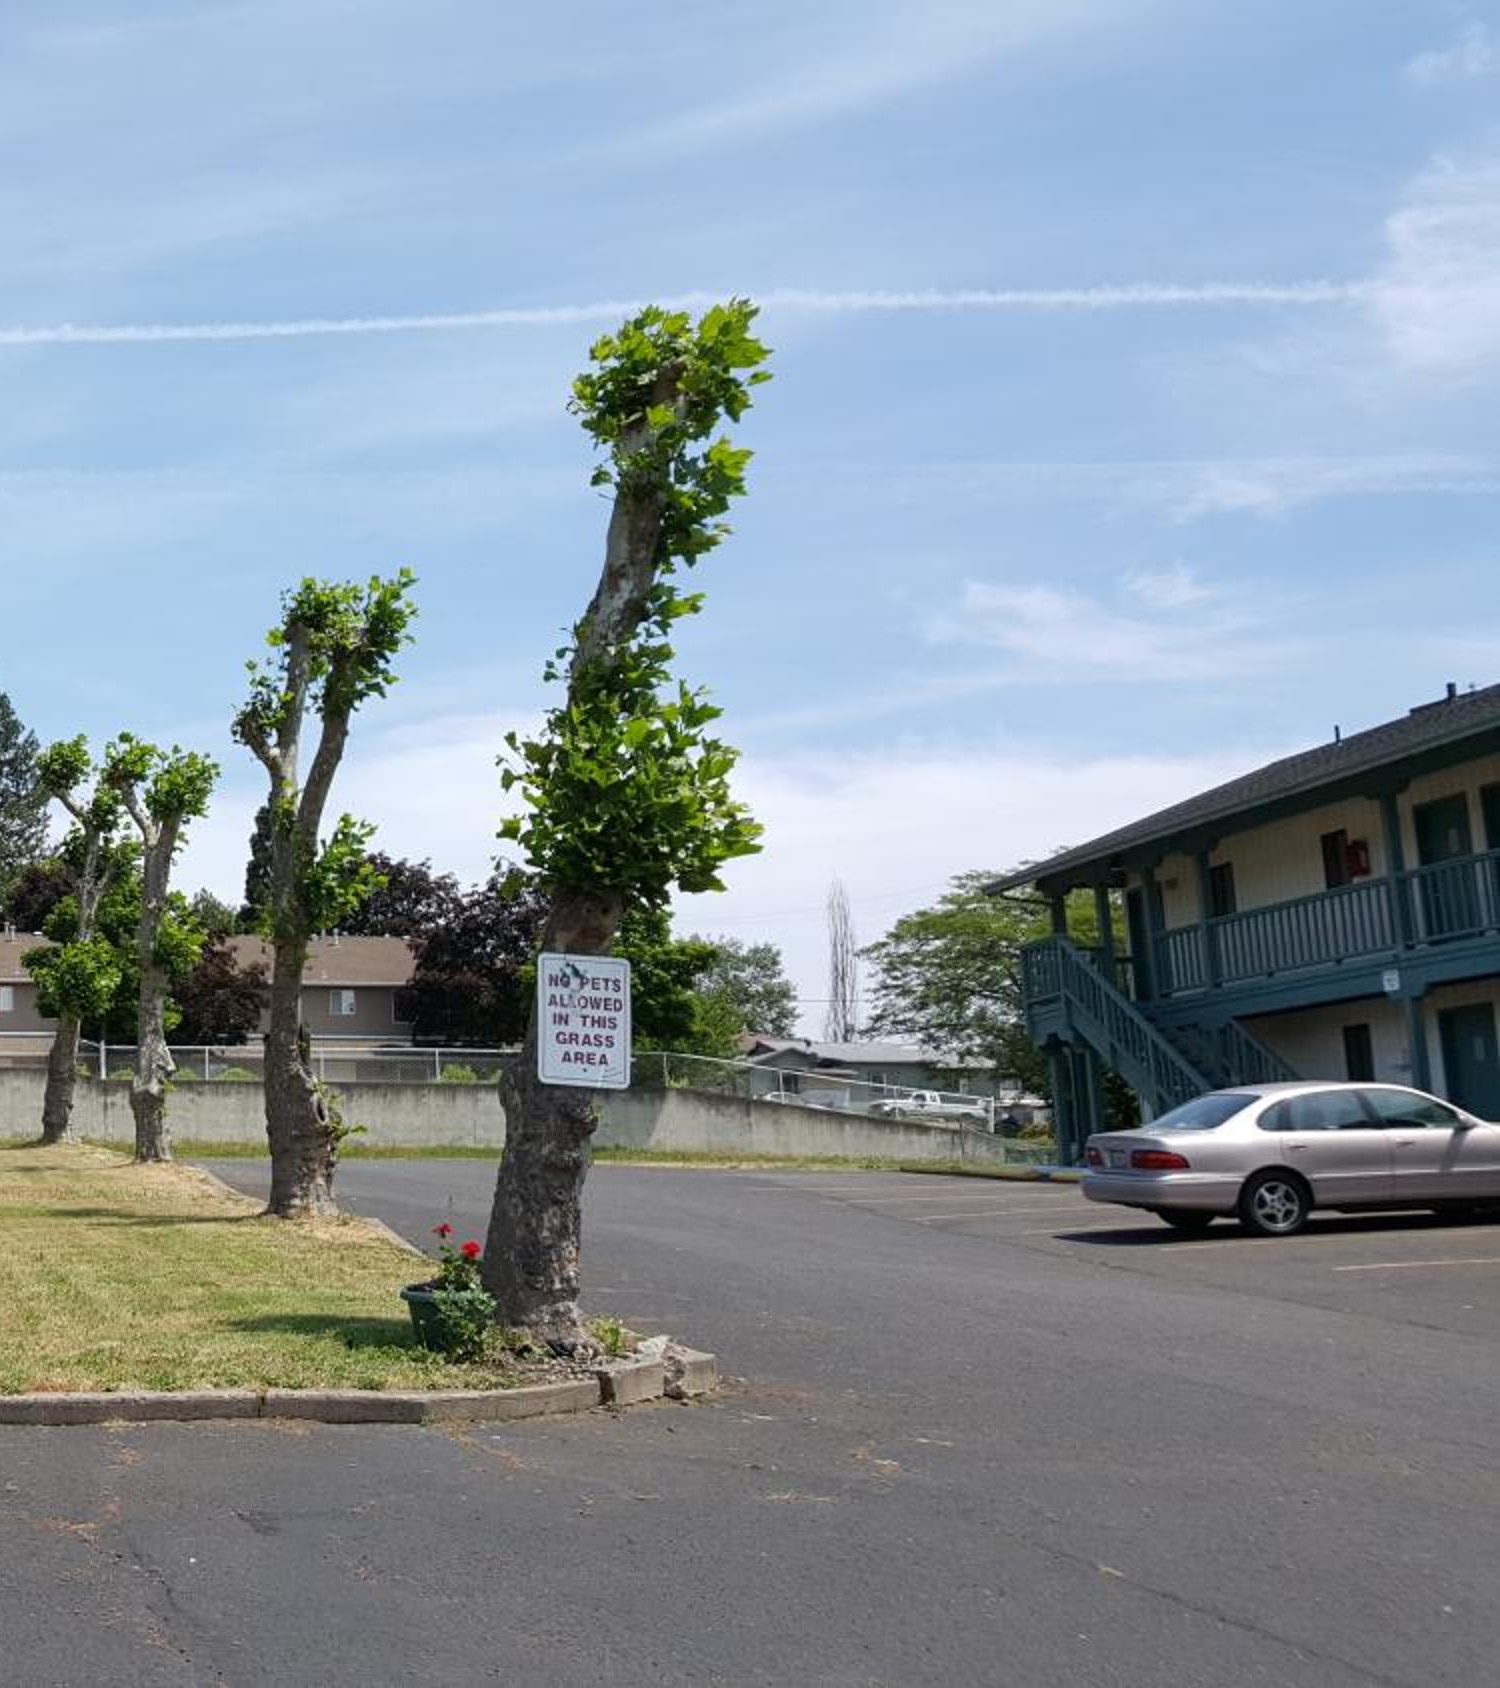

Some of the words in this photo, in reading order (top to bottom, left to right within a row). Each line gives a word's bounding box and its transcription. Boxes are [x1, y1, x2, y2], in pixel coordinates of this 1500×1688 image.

[548, 973, 570, 988] NO
[579, 976, 621, 993] PETS
[553, 1013, 569, 1026] IN
[579, 1014, 617, 1030] THIS
[556, 1031, 614, 1048] GRASS
[562, 1052, 608, 1066] AREA
